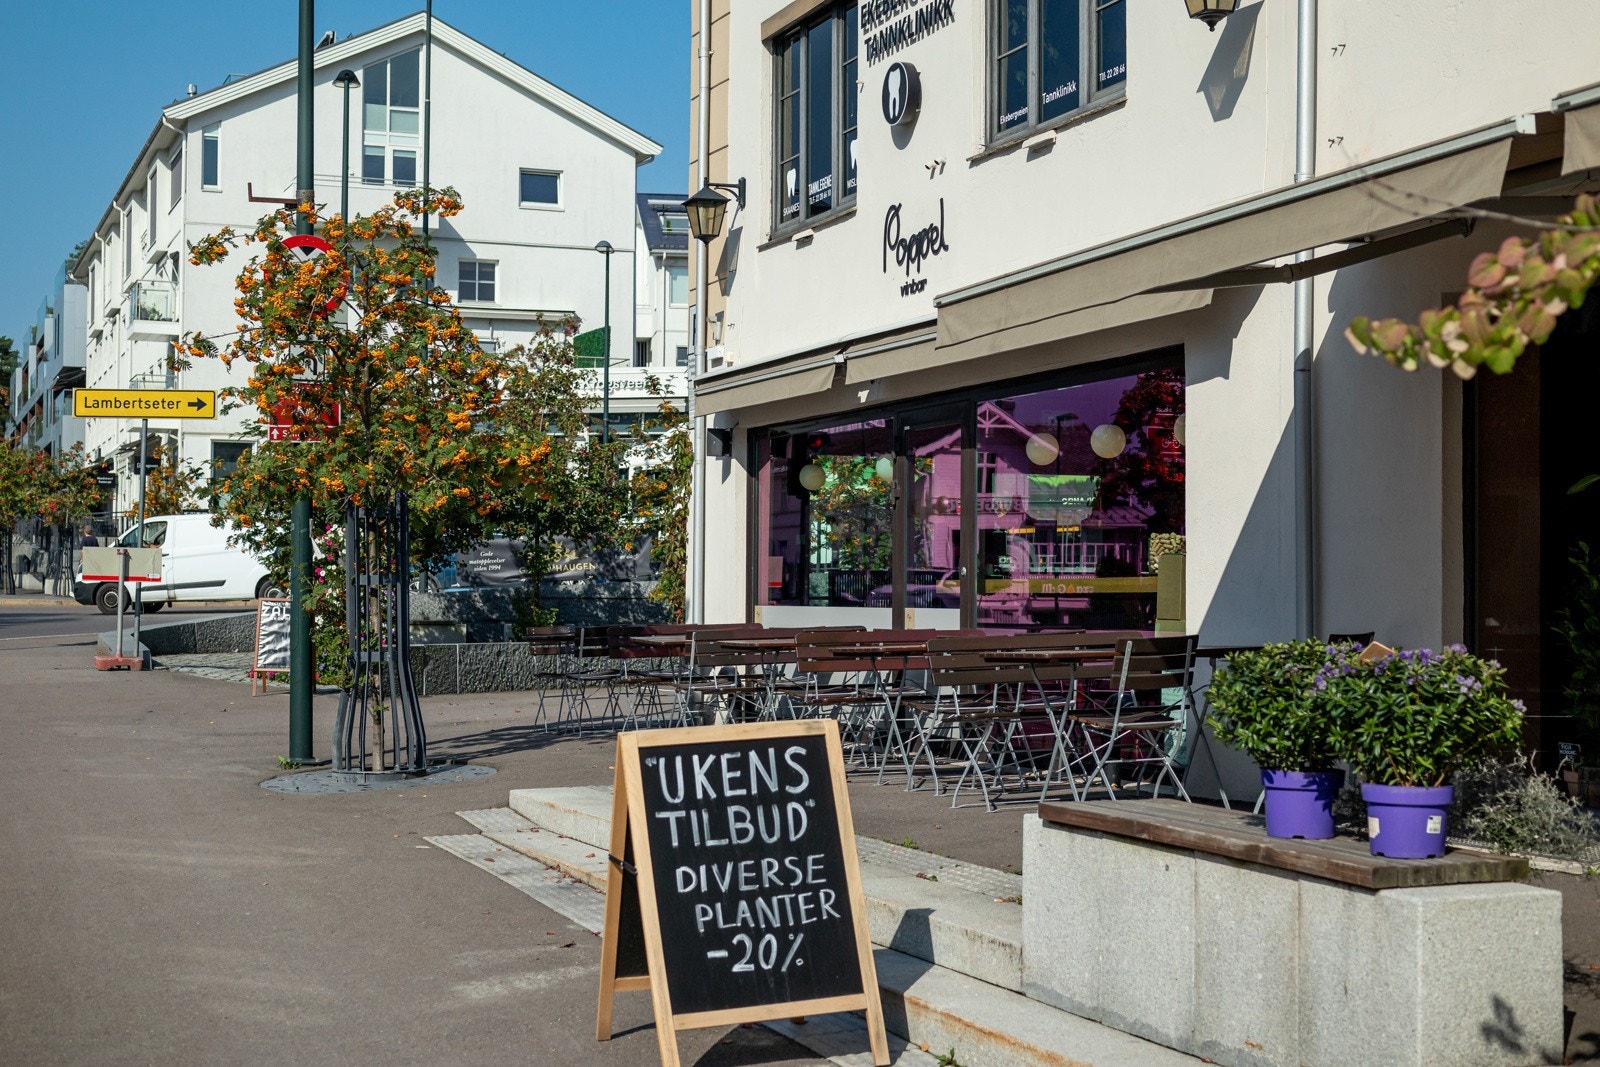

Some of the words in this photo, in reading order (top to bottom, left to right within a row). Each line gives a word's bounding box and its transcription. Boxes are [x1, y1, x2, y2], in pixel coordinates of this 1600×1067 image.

[864, 0, 955, 64] TANNKLINIKK
[1042, 80, 1077, 105] Tannklinikk
[883, 197, 949, 278] Poppel
[900, 278, 928, 298] vinbar
[84, 396, 182, 410] Lambertseter
[479, 550, 494, 558] Gode
[675, 853, 826, 893] DIVERSE
[694, 888, 841, 933] PLANTER
[707, 933, 804, 972] -20%
